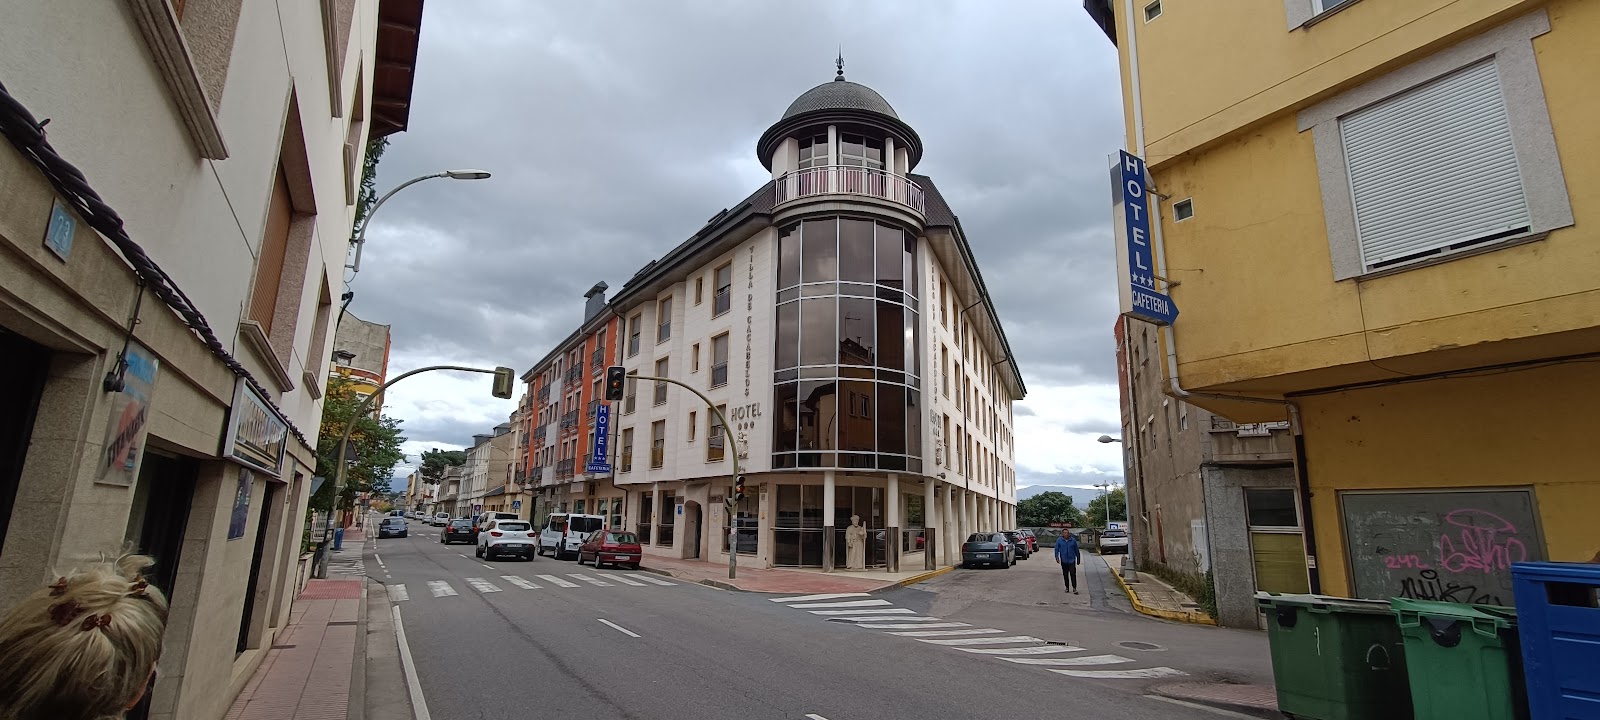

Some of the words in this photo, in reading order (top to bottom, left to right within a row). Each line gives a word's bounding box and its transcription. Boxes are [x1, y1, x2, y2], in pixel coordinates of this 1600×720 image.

[1126, 155, 1148, 270] HOTEL
[747, 293, 753, 311] DE
[1131, 290, 1170, 316] CAFETERIA
[731, 402, 762, 421] HOTEL
[598, 405, 606, 456] HOTEL
